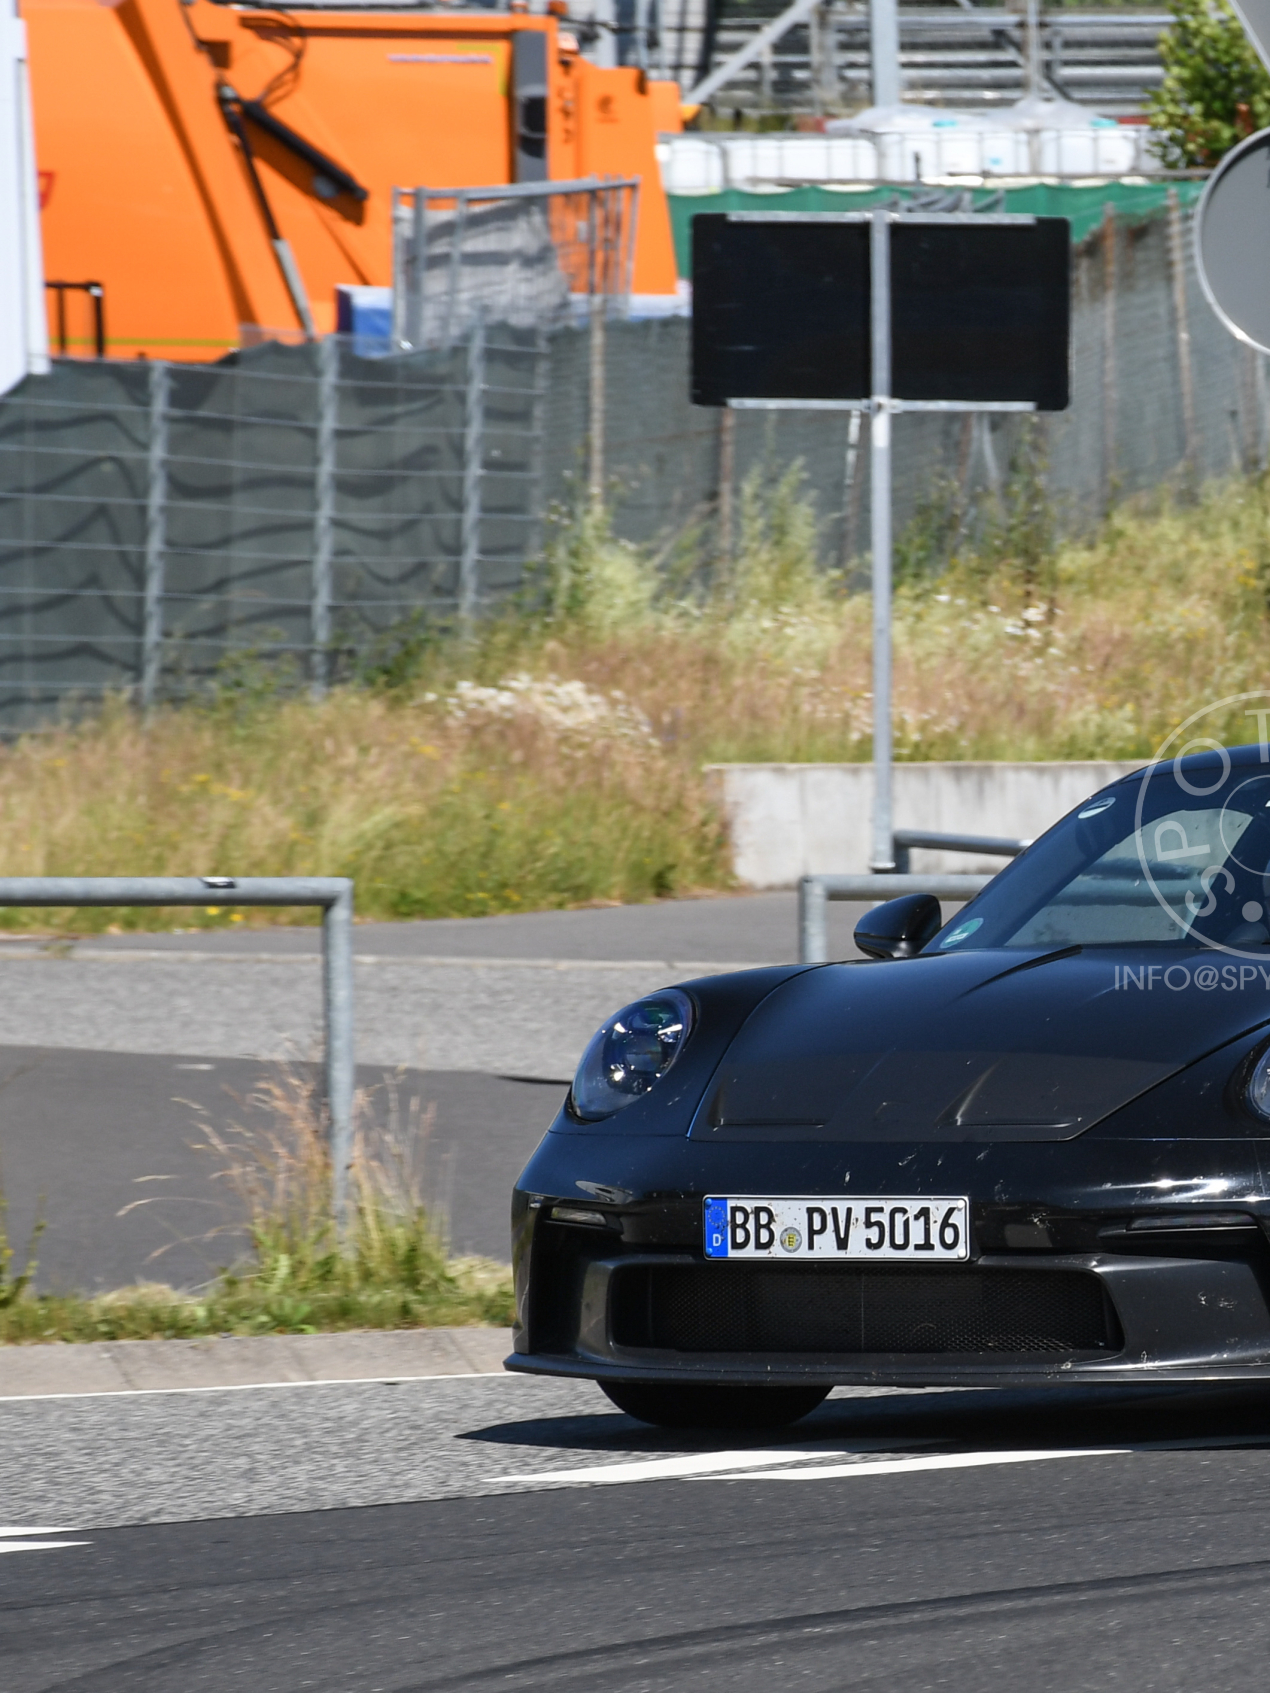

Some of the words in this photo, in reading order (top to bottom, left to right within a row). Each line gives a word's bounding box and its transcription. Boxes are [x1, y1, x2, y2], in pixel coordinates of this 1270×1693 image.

[712, 1234, 722, 1247] D
[730, 1206, 776, 1251] BB
[806, 1207, 853, 1250] PV
[865, 1207, 960, 1251] 5016
